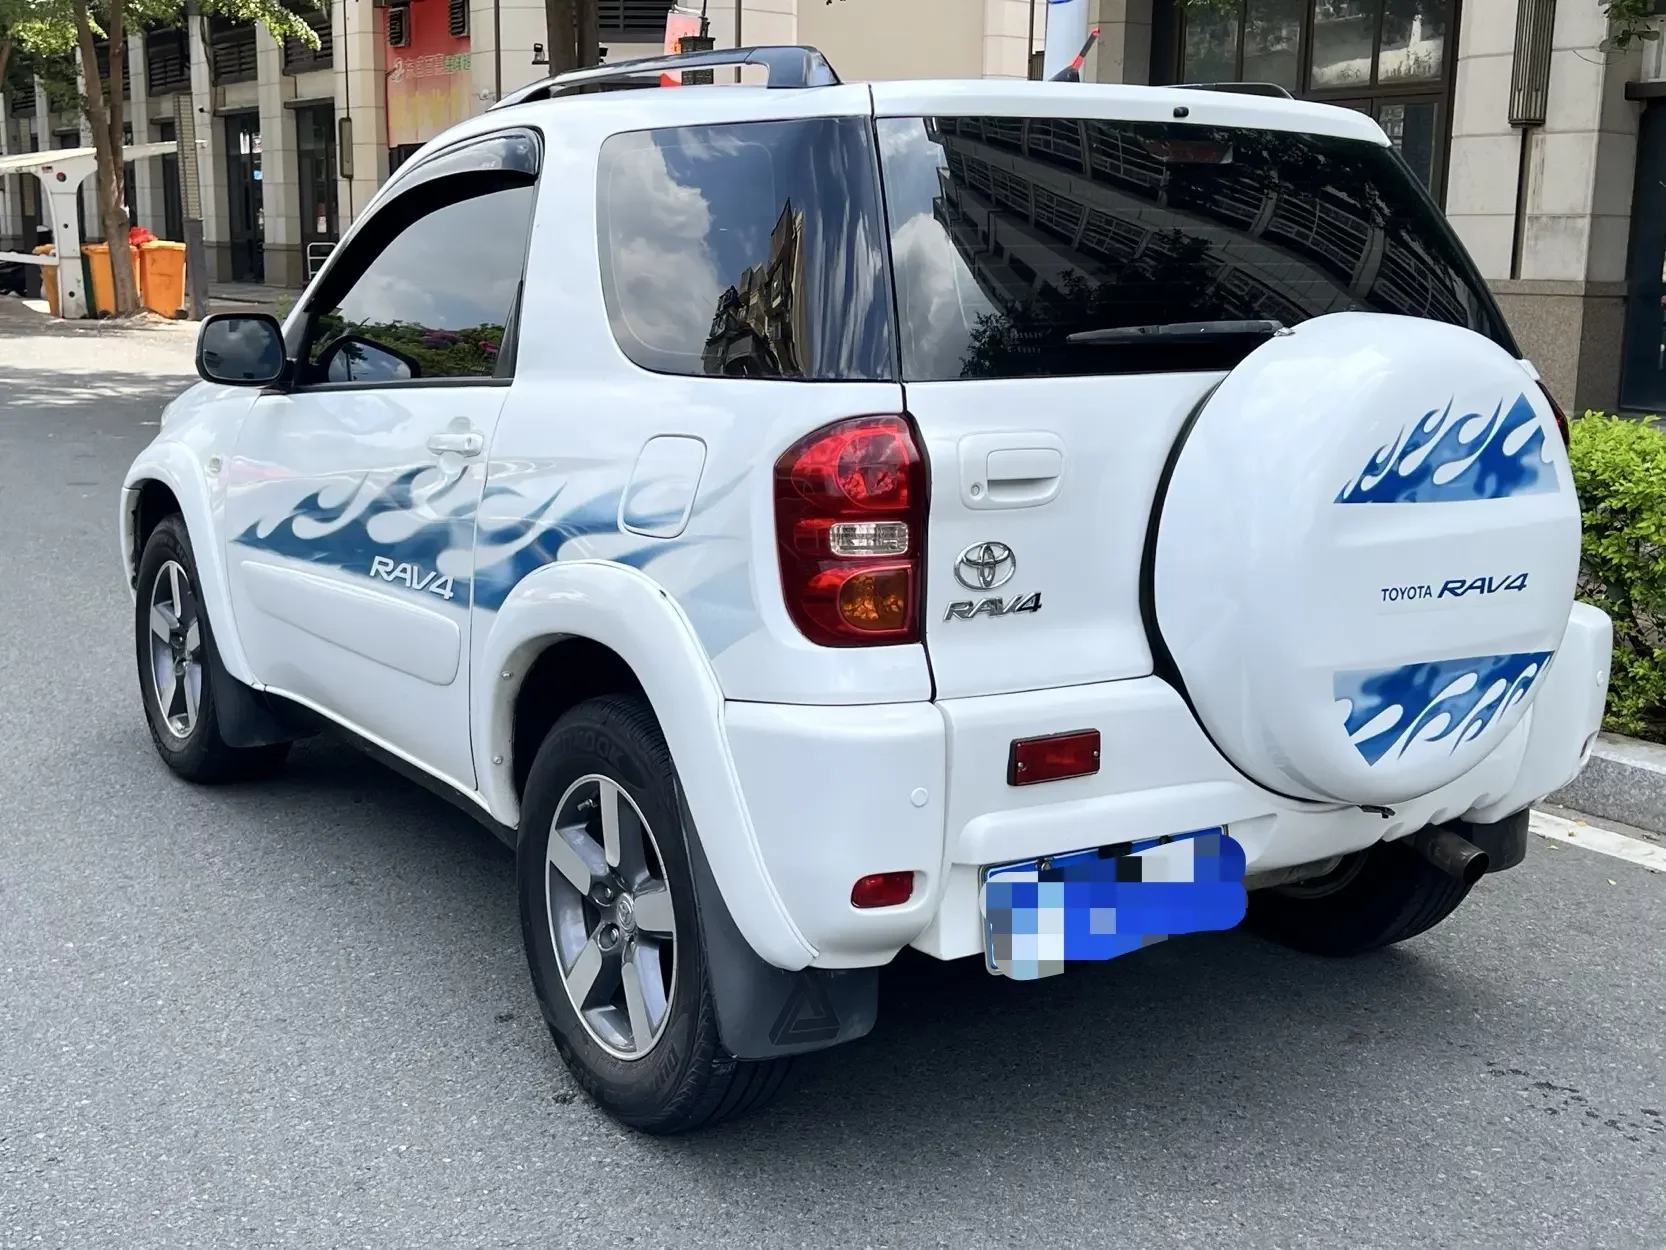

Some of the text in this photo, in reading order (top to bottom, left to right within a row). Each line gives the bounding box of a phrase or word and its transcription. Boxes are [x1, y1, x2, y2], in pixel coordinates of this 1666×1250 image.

[369, 555, 454, 600] RAV4
[1381, 573, 1528, 601] TOYOTA RAV4
[943, 591, 1042, 620] RAV4
